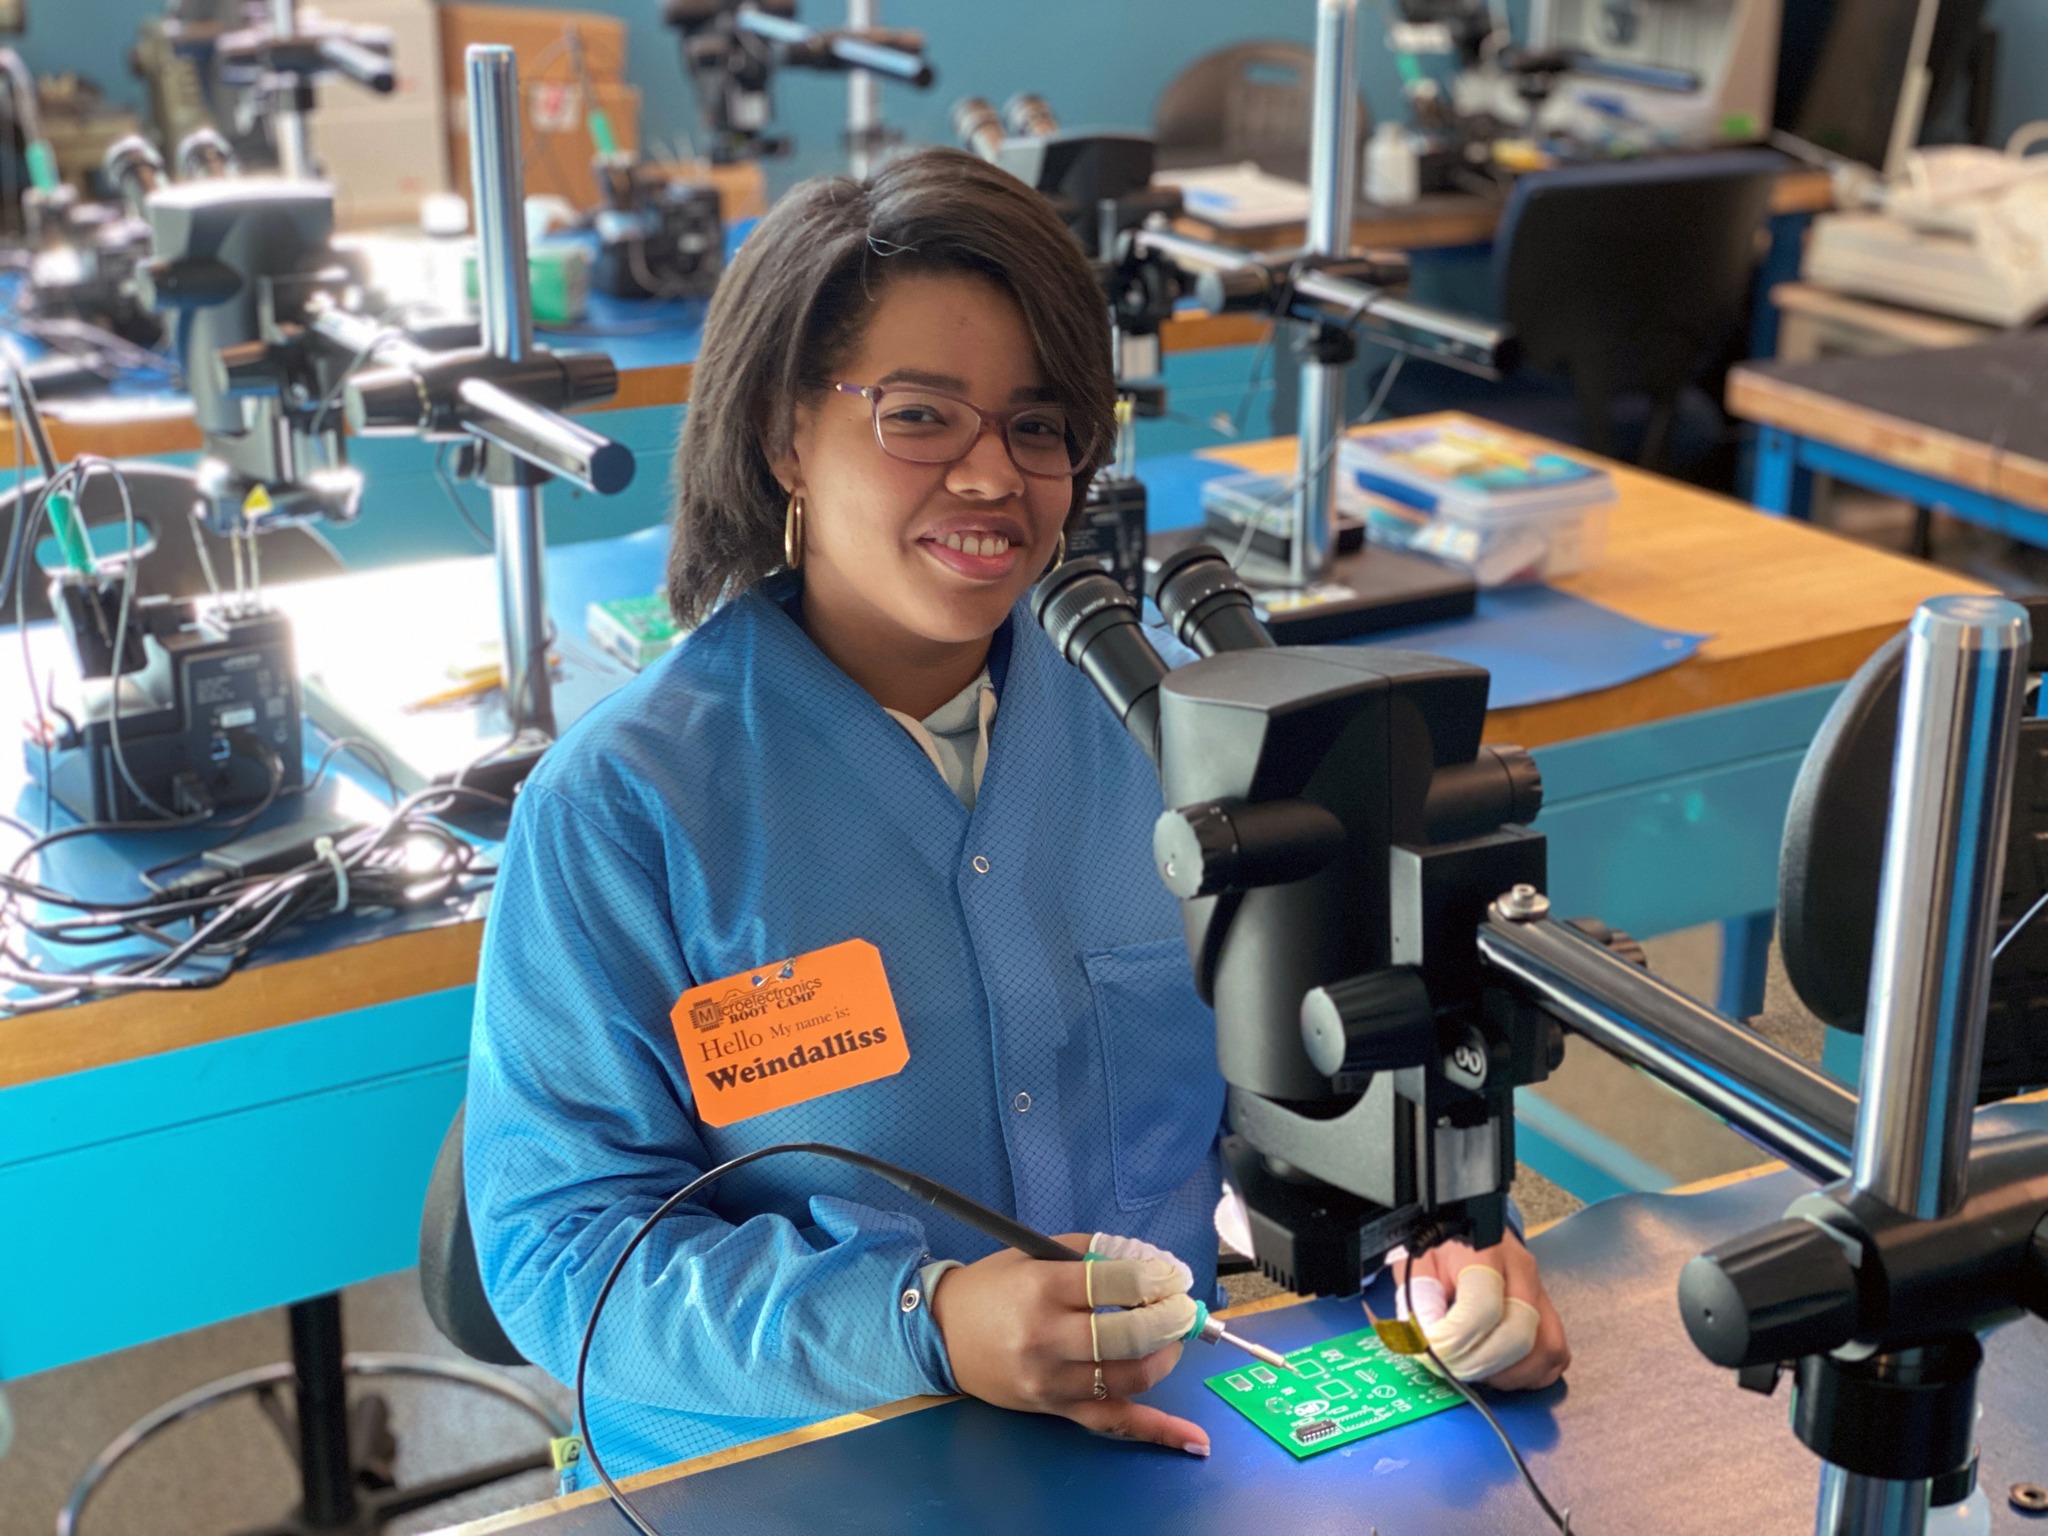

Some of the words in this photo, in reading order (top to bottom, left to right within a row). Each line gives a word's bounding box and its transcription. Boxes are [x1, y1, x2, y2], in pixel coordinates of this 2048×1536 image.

[699, 1030, 763, 1063] Hello
[769, 1023, 793, 1039] My
[795, 1013, 832, 1032] name
[835, 1007, 851, 1020] is:
[729, 1005, 768, 1024] BOOT
[776, 990, 816, 1010] CAMP
[706, 1026, 888, 1092] Weindalliss
